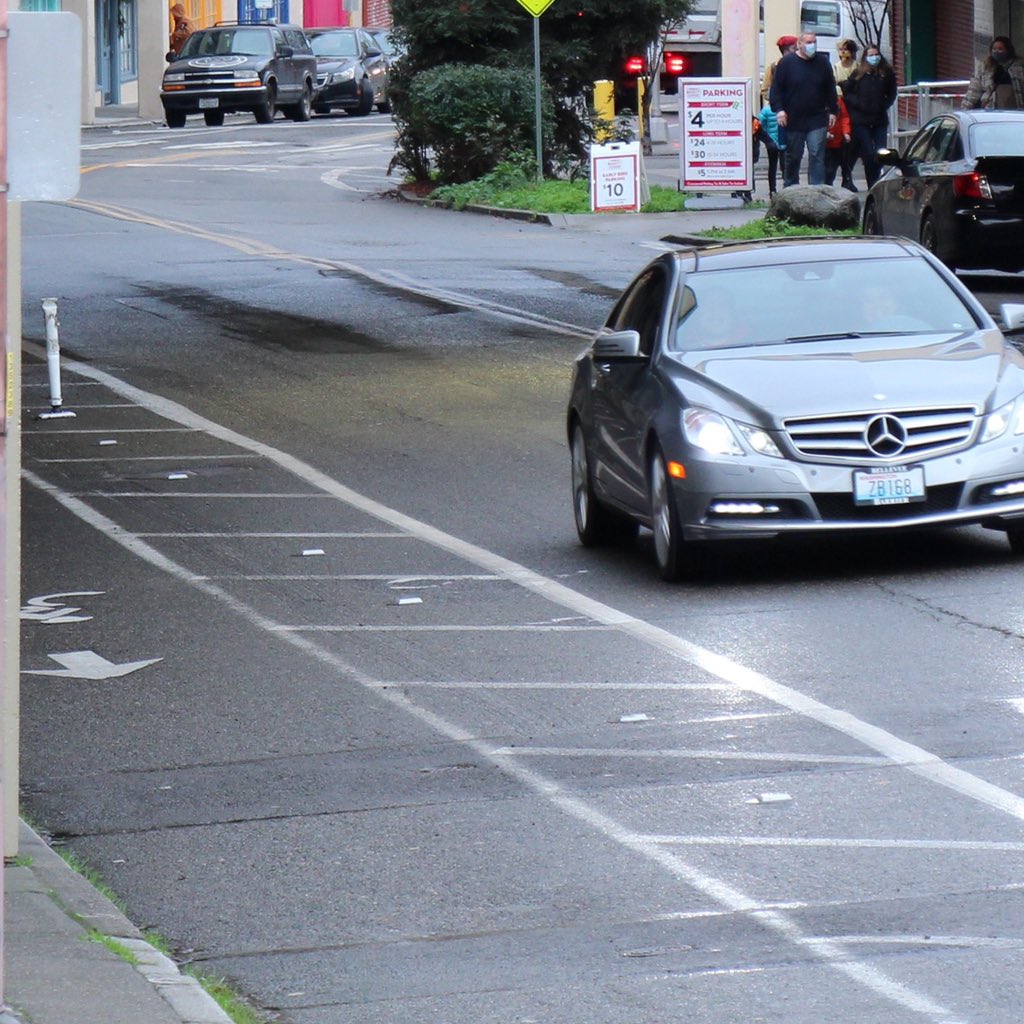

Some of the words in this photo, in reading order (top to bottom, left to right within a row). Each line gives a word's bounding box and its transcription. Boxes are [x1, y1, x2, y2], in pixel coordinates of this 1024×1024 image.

[703, 89, 743, 97] PARKING
[688, 111, 705, 128] $4
[603, 183, 624, 197] $10
